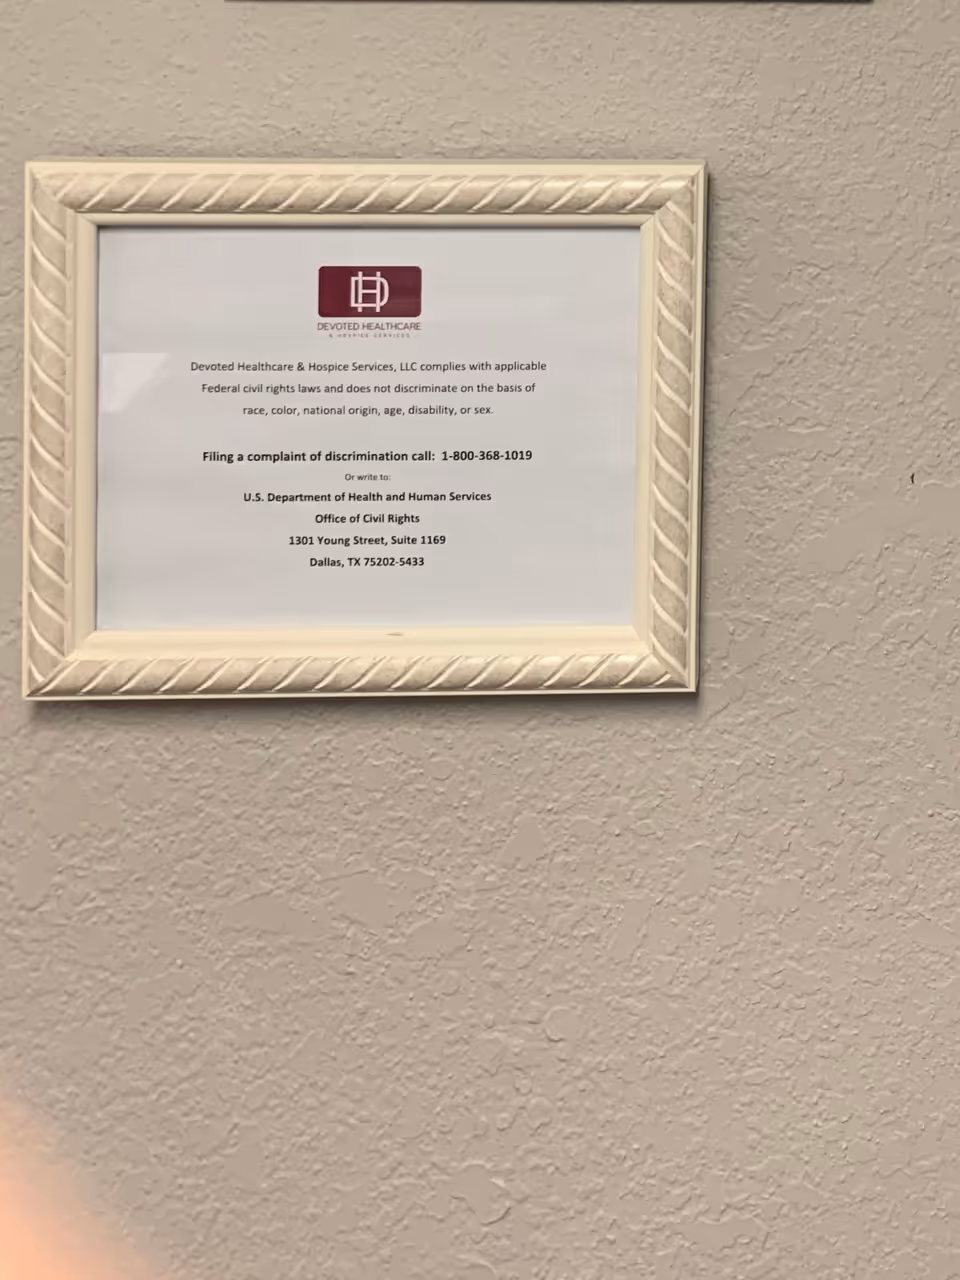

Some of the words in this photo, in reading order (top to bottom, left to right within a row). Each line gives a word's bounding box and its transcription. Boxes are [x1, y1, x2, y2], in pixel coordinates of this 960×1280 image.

[317, 322, 360, 330] DEVOTED
[362, 322, 420, 330] HEALTHCARE
[190, 362, 234, 371] Devoted
[237, 362, 293, 371] Healthcare
[296, 362, 304, 371] &
[308, 362, 349, 373] Hospice
[352, 362, 396, 372] Services,
[400, 362, 417, 371] LLC
[420, 361, 466, 372] complies
[468, 361, 491, 370] with
[494, 361, 546, 372] applicable
[202, 384, 240, 392] Federal
[243, 384, 262, 392] civil
[266, 384, 295, 395] rights
[298, 384, 321, 393] laws
[324, 384, 343, 392] and
[346, 384, 371, 393] does
[374, 384, 390, 393] not
[394, 384, 457, 393] discriminate
[476, 383, 494, 392] the
[496, 383, 522, 392] basis
[524, 383, 535, 392] of
[243, 407, 268, 416] race,
[271, 405, 300, 416] color,
[303, 405, 345, 415] national
[348, 406, 380, 416] origin,
[384, 407, 404, 416] age,
[408, 405, 457, 416] disability,
[203, 451, 234, 463] Filing
[247, 451, 306, 463] complaint
[310, 451, 321, 461] of
[325, 451, 408, 461] discrimination
[411, 451, 434, 461] call:
[442, 450, 532, 460] 1-800-368-1019
[244, 492, 264, 501] U.S.
[267, 493, 331, 503] Department
[334, 492, 345, 501] of
[348, 492, 382, 501] Health
[386, 492, 405, 501] and
[408, 492, 446, 501] Human
[449, 492, 491, 501] Services
[315, 514, 346, 523] Office
[349, 513, 360, 523] of
[362, 514, 384, 523] Civil
[388, 513, 420, 524] Rights
[289, 536, 313, 545] 1301
[317, 536, 350, 547] Young
[353, 536, 388, 546] Street,
[391, 535, 417, 544] Suite
[421, 535, 446, 544] 1169
[310, 557, 344, 567] Dallas,
[347, 557, 360, 566] TX
[364, 557, 424, 566] 75202-5433
